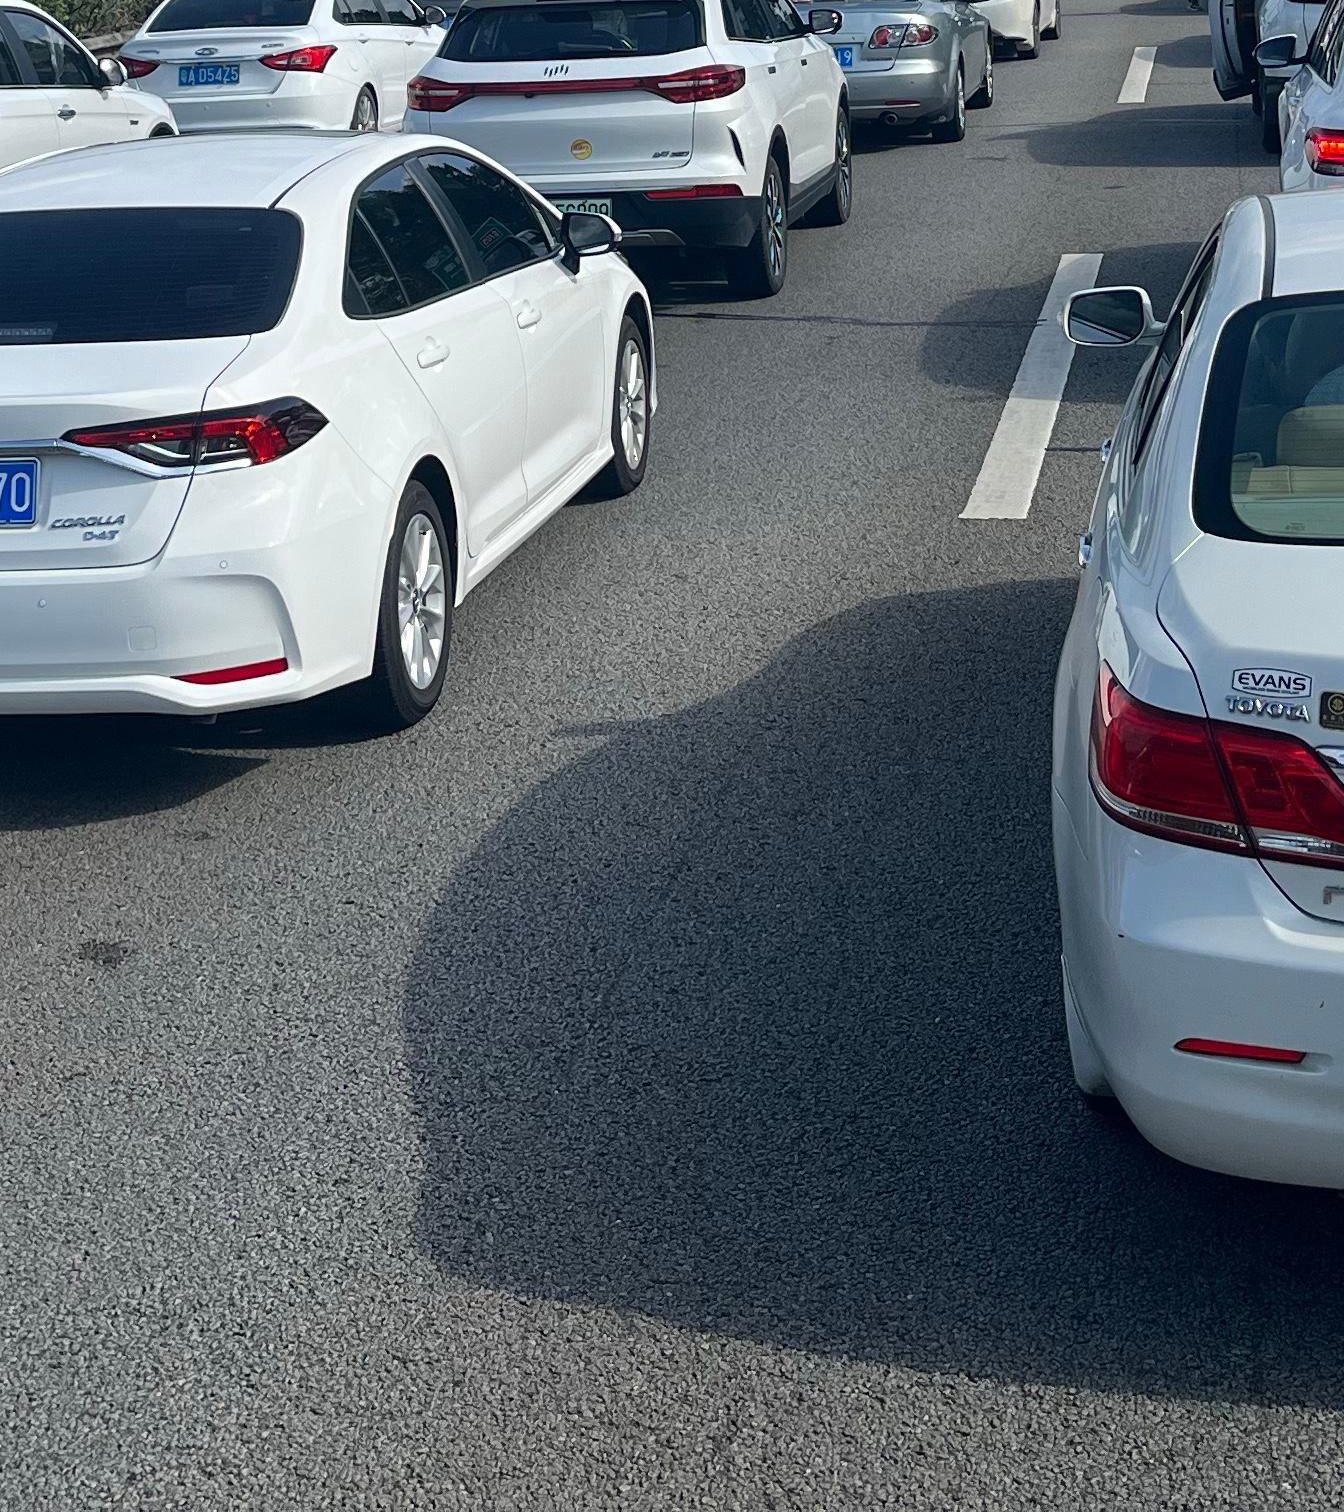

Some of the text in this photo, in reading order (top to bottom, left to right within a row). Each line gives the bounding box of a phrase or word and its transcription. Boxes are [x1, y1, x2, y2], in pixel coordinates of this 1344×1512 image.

[49, 513, 126, 530] COROLLA
[1237, 672, 1307, 691] EVANS
[1226, 694, 1312, 724] TOYOTA
